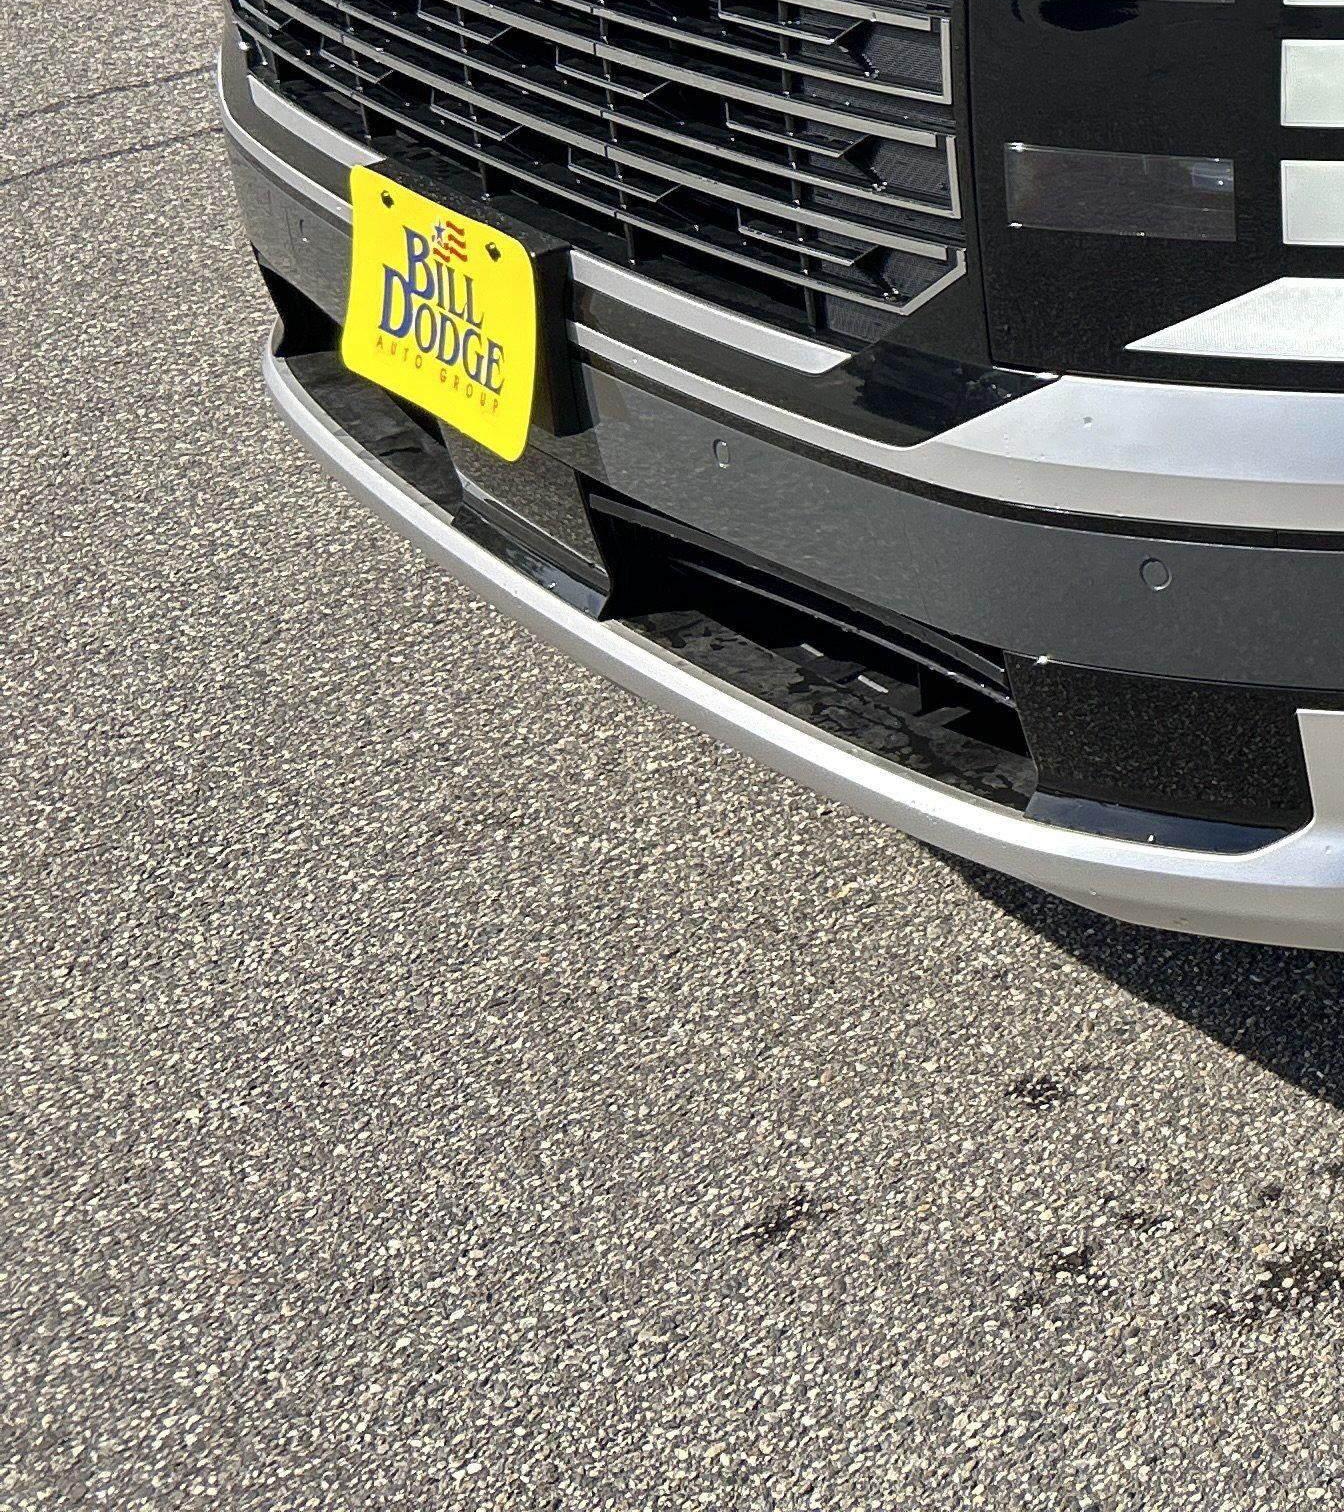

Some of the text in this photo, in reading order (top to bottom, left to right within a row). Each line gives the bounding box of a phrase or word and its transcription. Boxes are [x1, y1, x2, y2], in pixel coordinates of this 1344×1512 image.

[402, 225, 484, 328] BILL
[375, 335, 499, 413] AUTO GROUP
[378, 262, 505, 396] DODGE
